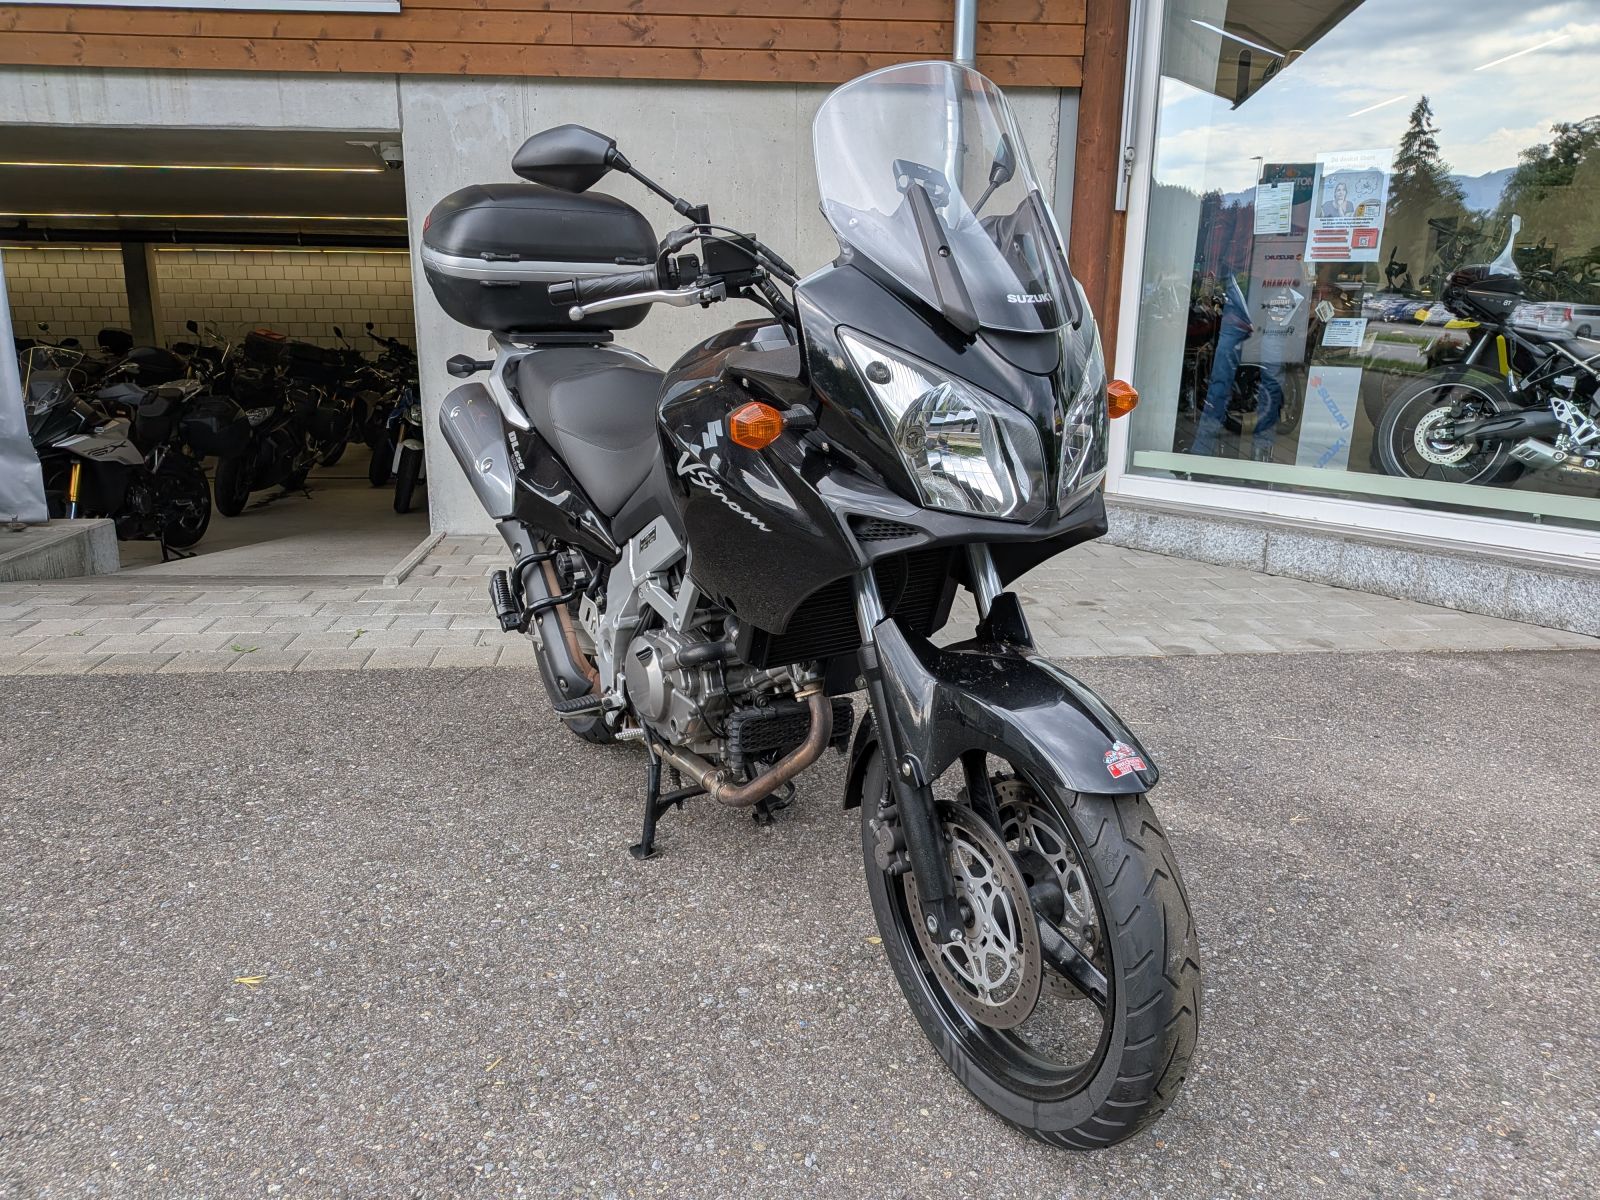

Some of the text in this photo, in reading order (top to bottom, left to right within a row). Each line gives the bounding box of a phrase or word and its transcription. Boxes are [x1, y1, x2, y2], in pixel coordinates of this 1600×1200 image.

[1006, 292, 1053, 304] SUZUKI
[1318, 387, 1349, 429] SUZUKI
[508, 430, 525, 470] DL650
